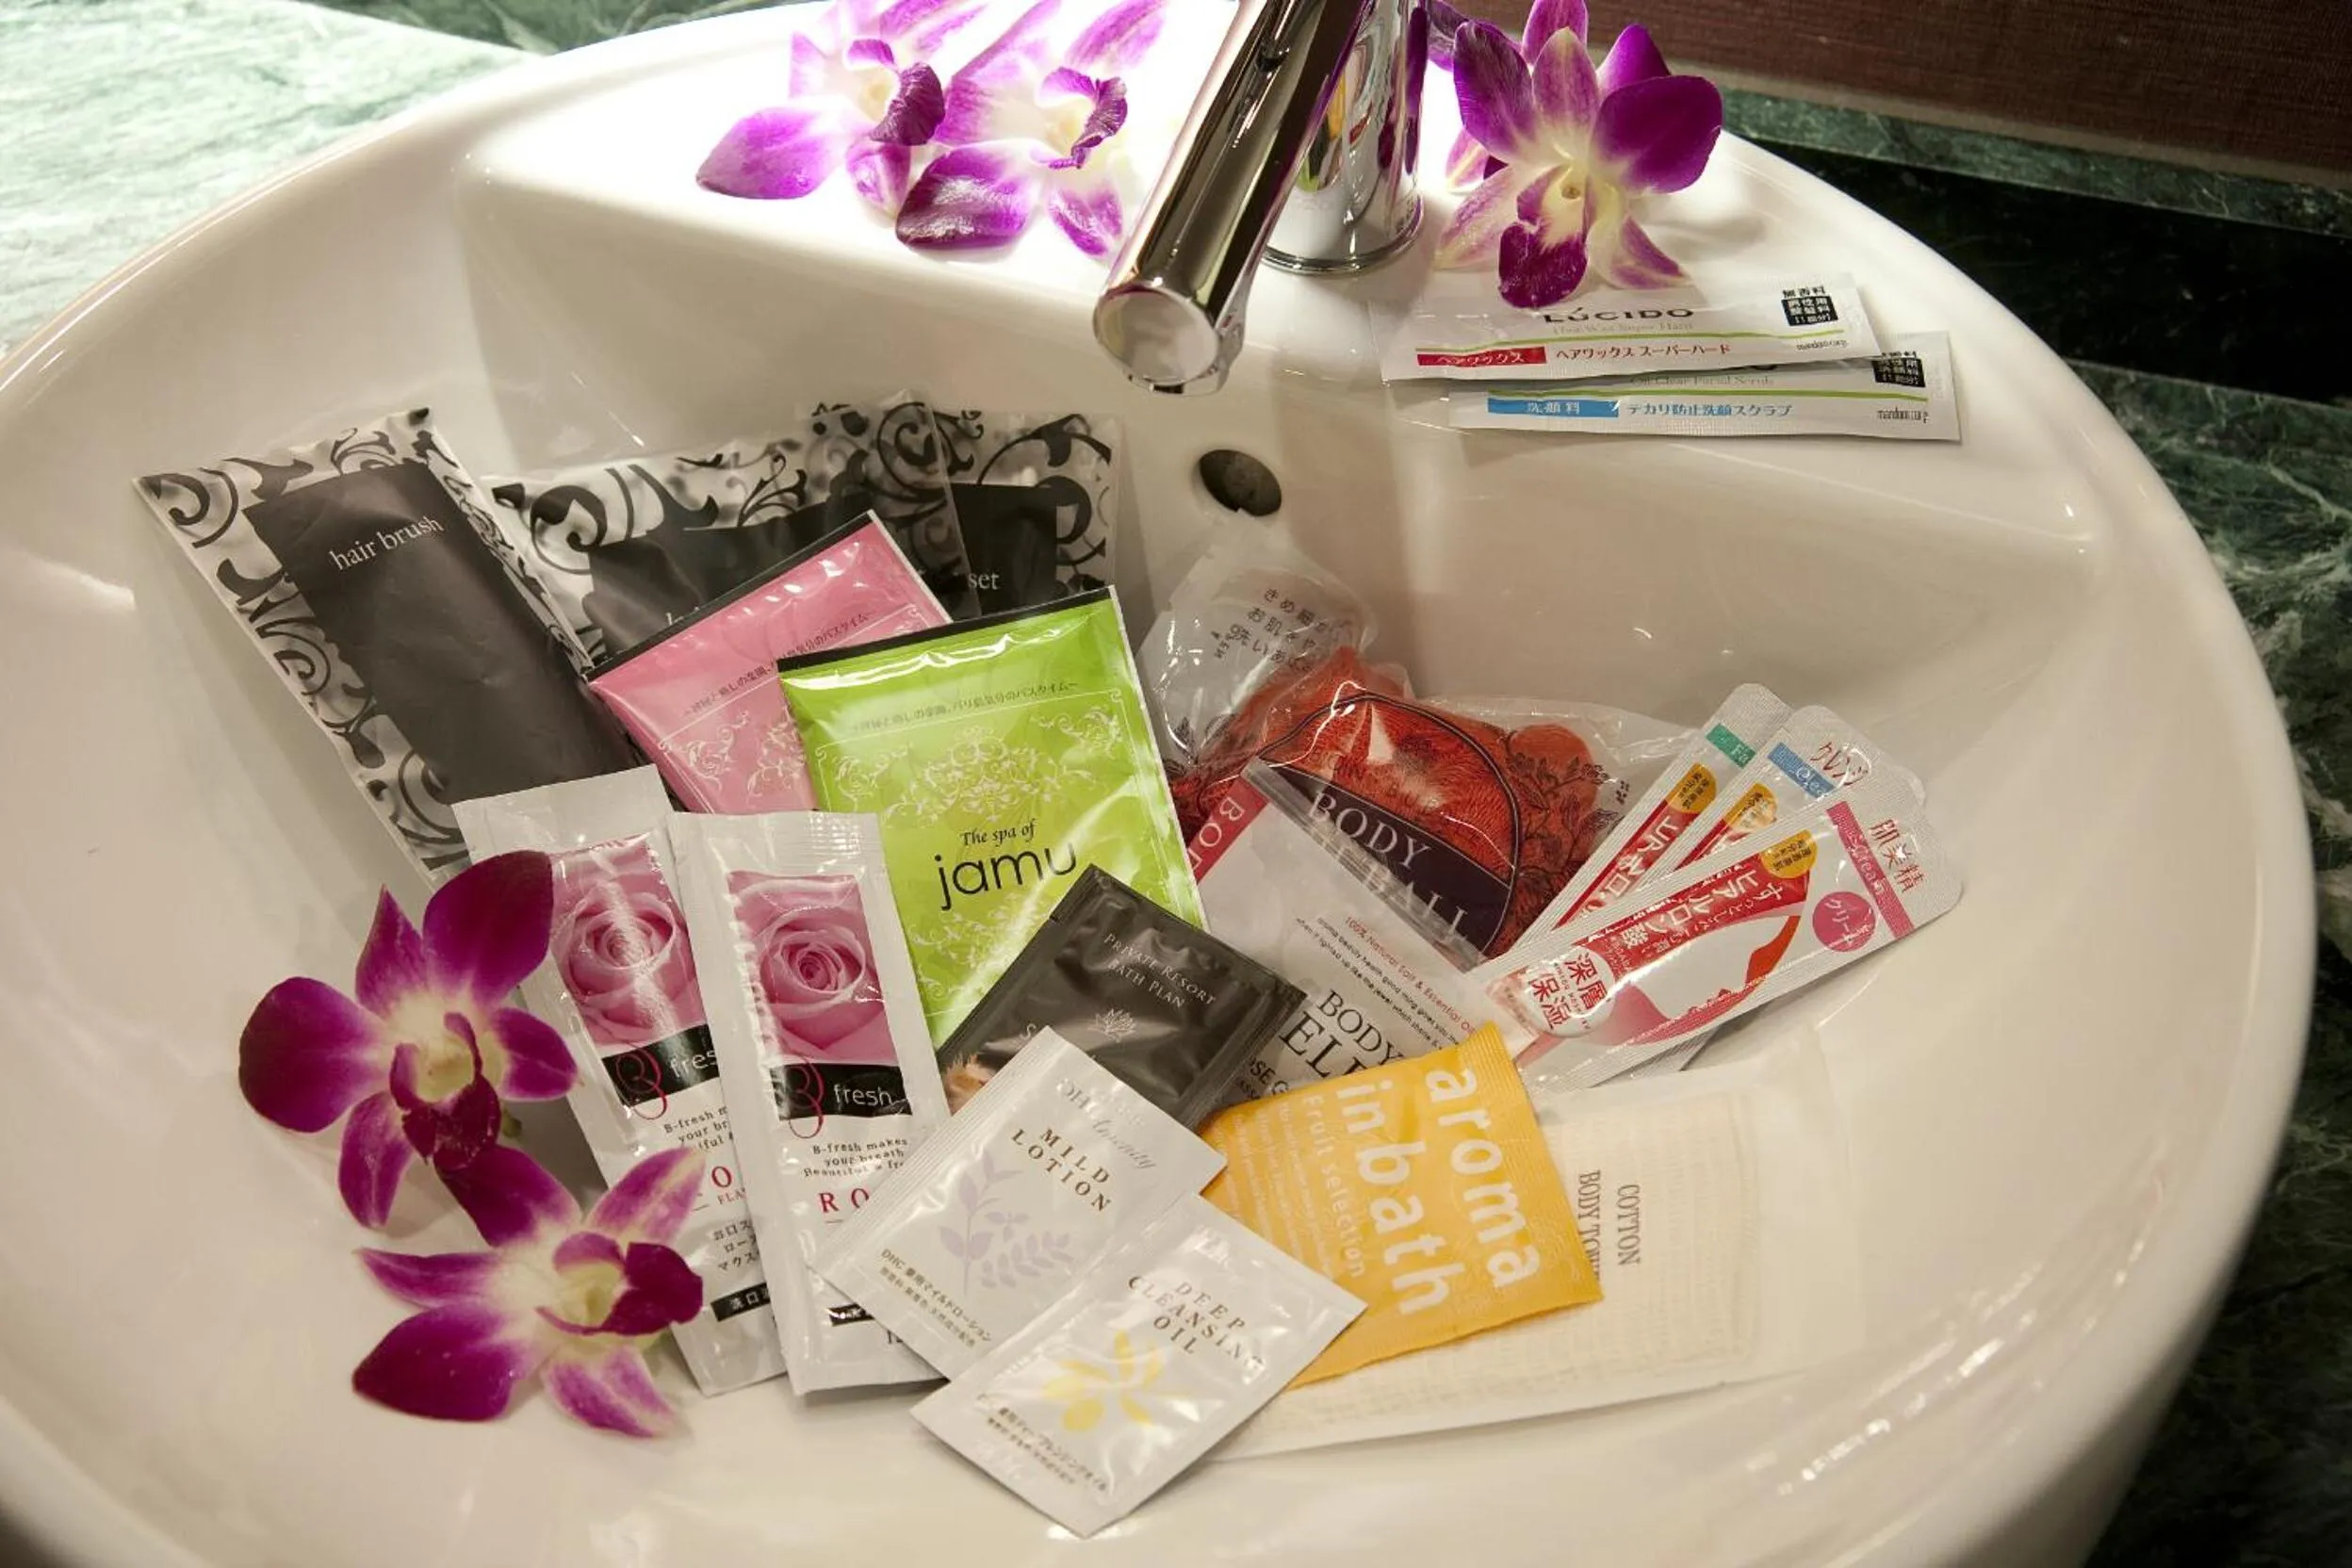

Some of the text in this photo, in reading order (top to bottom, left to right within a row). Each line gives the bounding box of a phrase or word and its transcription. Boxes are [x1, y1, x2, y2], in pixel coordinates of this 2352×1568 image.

[1527, 400, 1580, 416] 洗顔料
[328, 514, 446, 571] hair brush
[959, 817, 1038, 847] The spa of
[1307, 792, 1433, 869] BODY
[1868, 817, 1926, 893] 肌美精
[933, 842, 1078, 912] jamu
[1618, 866, 1760, 952] ヒアルロン酸
[1107, 958, 1187, 1009] BATH PLAN
[1163, 963, 1217, 1007] RESORT
[1528, 973, 1574, 1029] 保湿
[1316, 988, 1406, 1066] BODY
[832, 1083, 895, 1107] fresh
[812, 1136, 908, 1156] B-fresh makes
[824, 1155, 854, 1168] your
[1011, 1128, 1112, 1213] LOTION
[1039, 1128, 1110, 1184] MILD
[1303, 1094, 1366, 1279] Fruit selection
[1335, 1078, 1467, 1315] in bath
[1425, 1068, 1542, 1291] aroma
[1576, 1169, 1602, 1220] BODY
[1615, 1184, 1642, 1266] COTTON
[1174, 1281, 1247, 1331] DEEP
[1152, 1315, 1198, 1356] OIL
